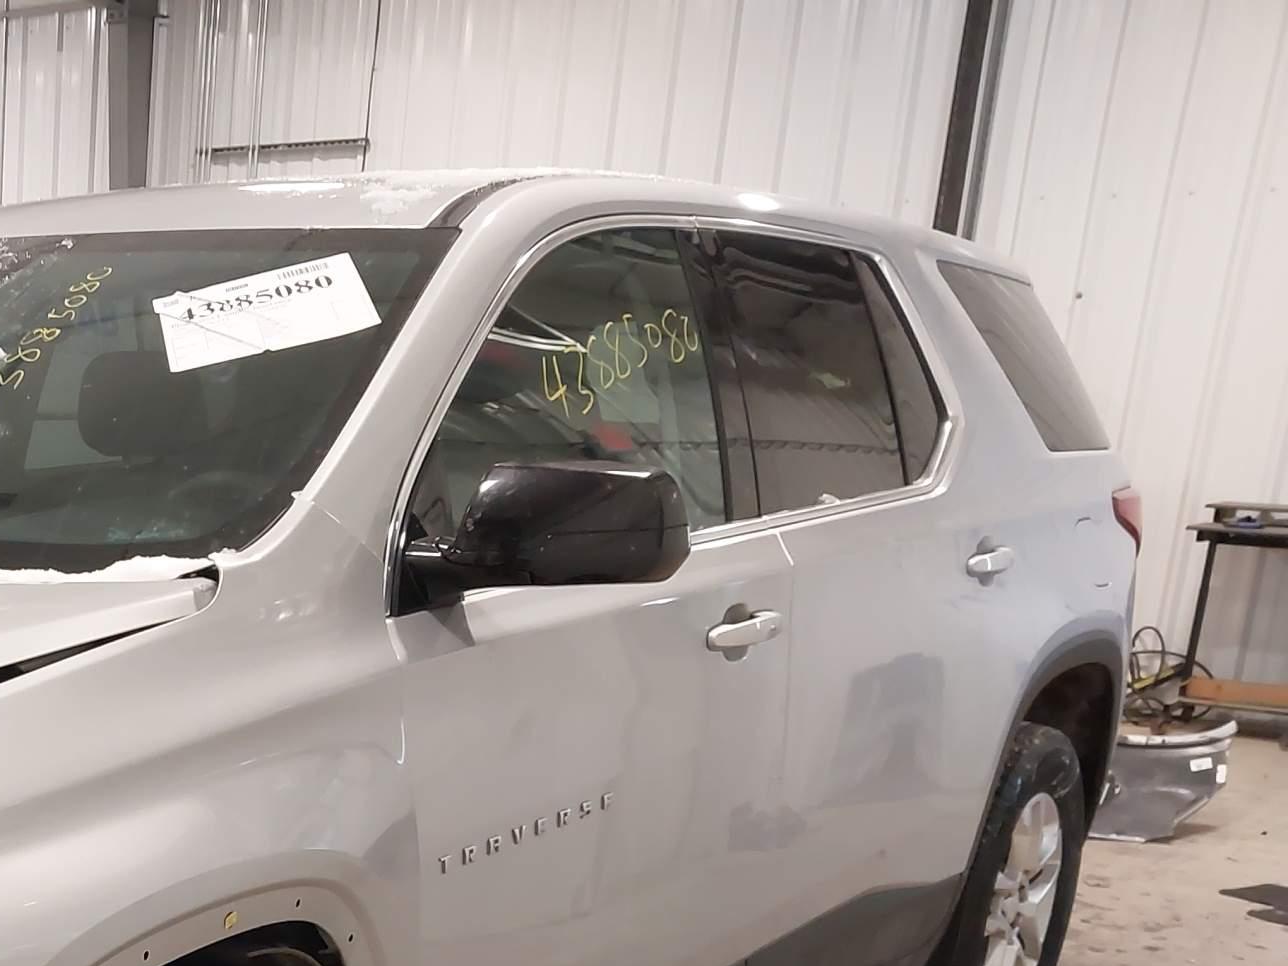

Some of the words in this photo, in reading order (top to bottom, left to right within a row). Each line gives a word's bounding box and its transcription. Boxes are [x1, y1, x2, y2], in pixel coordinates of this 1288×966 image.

[179, 274, 333, 321] 43885080
[543, 309, 699, 419] 43885080
[438, 792, 614, 874] TRAVERSE
